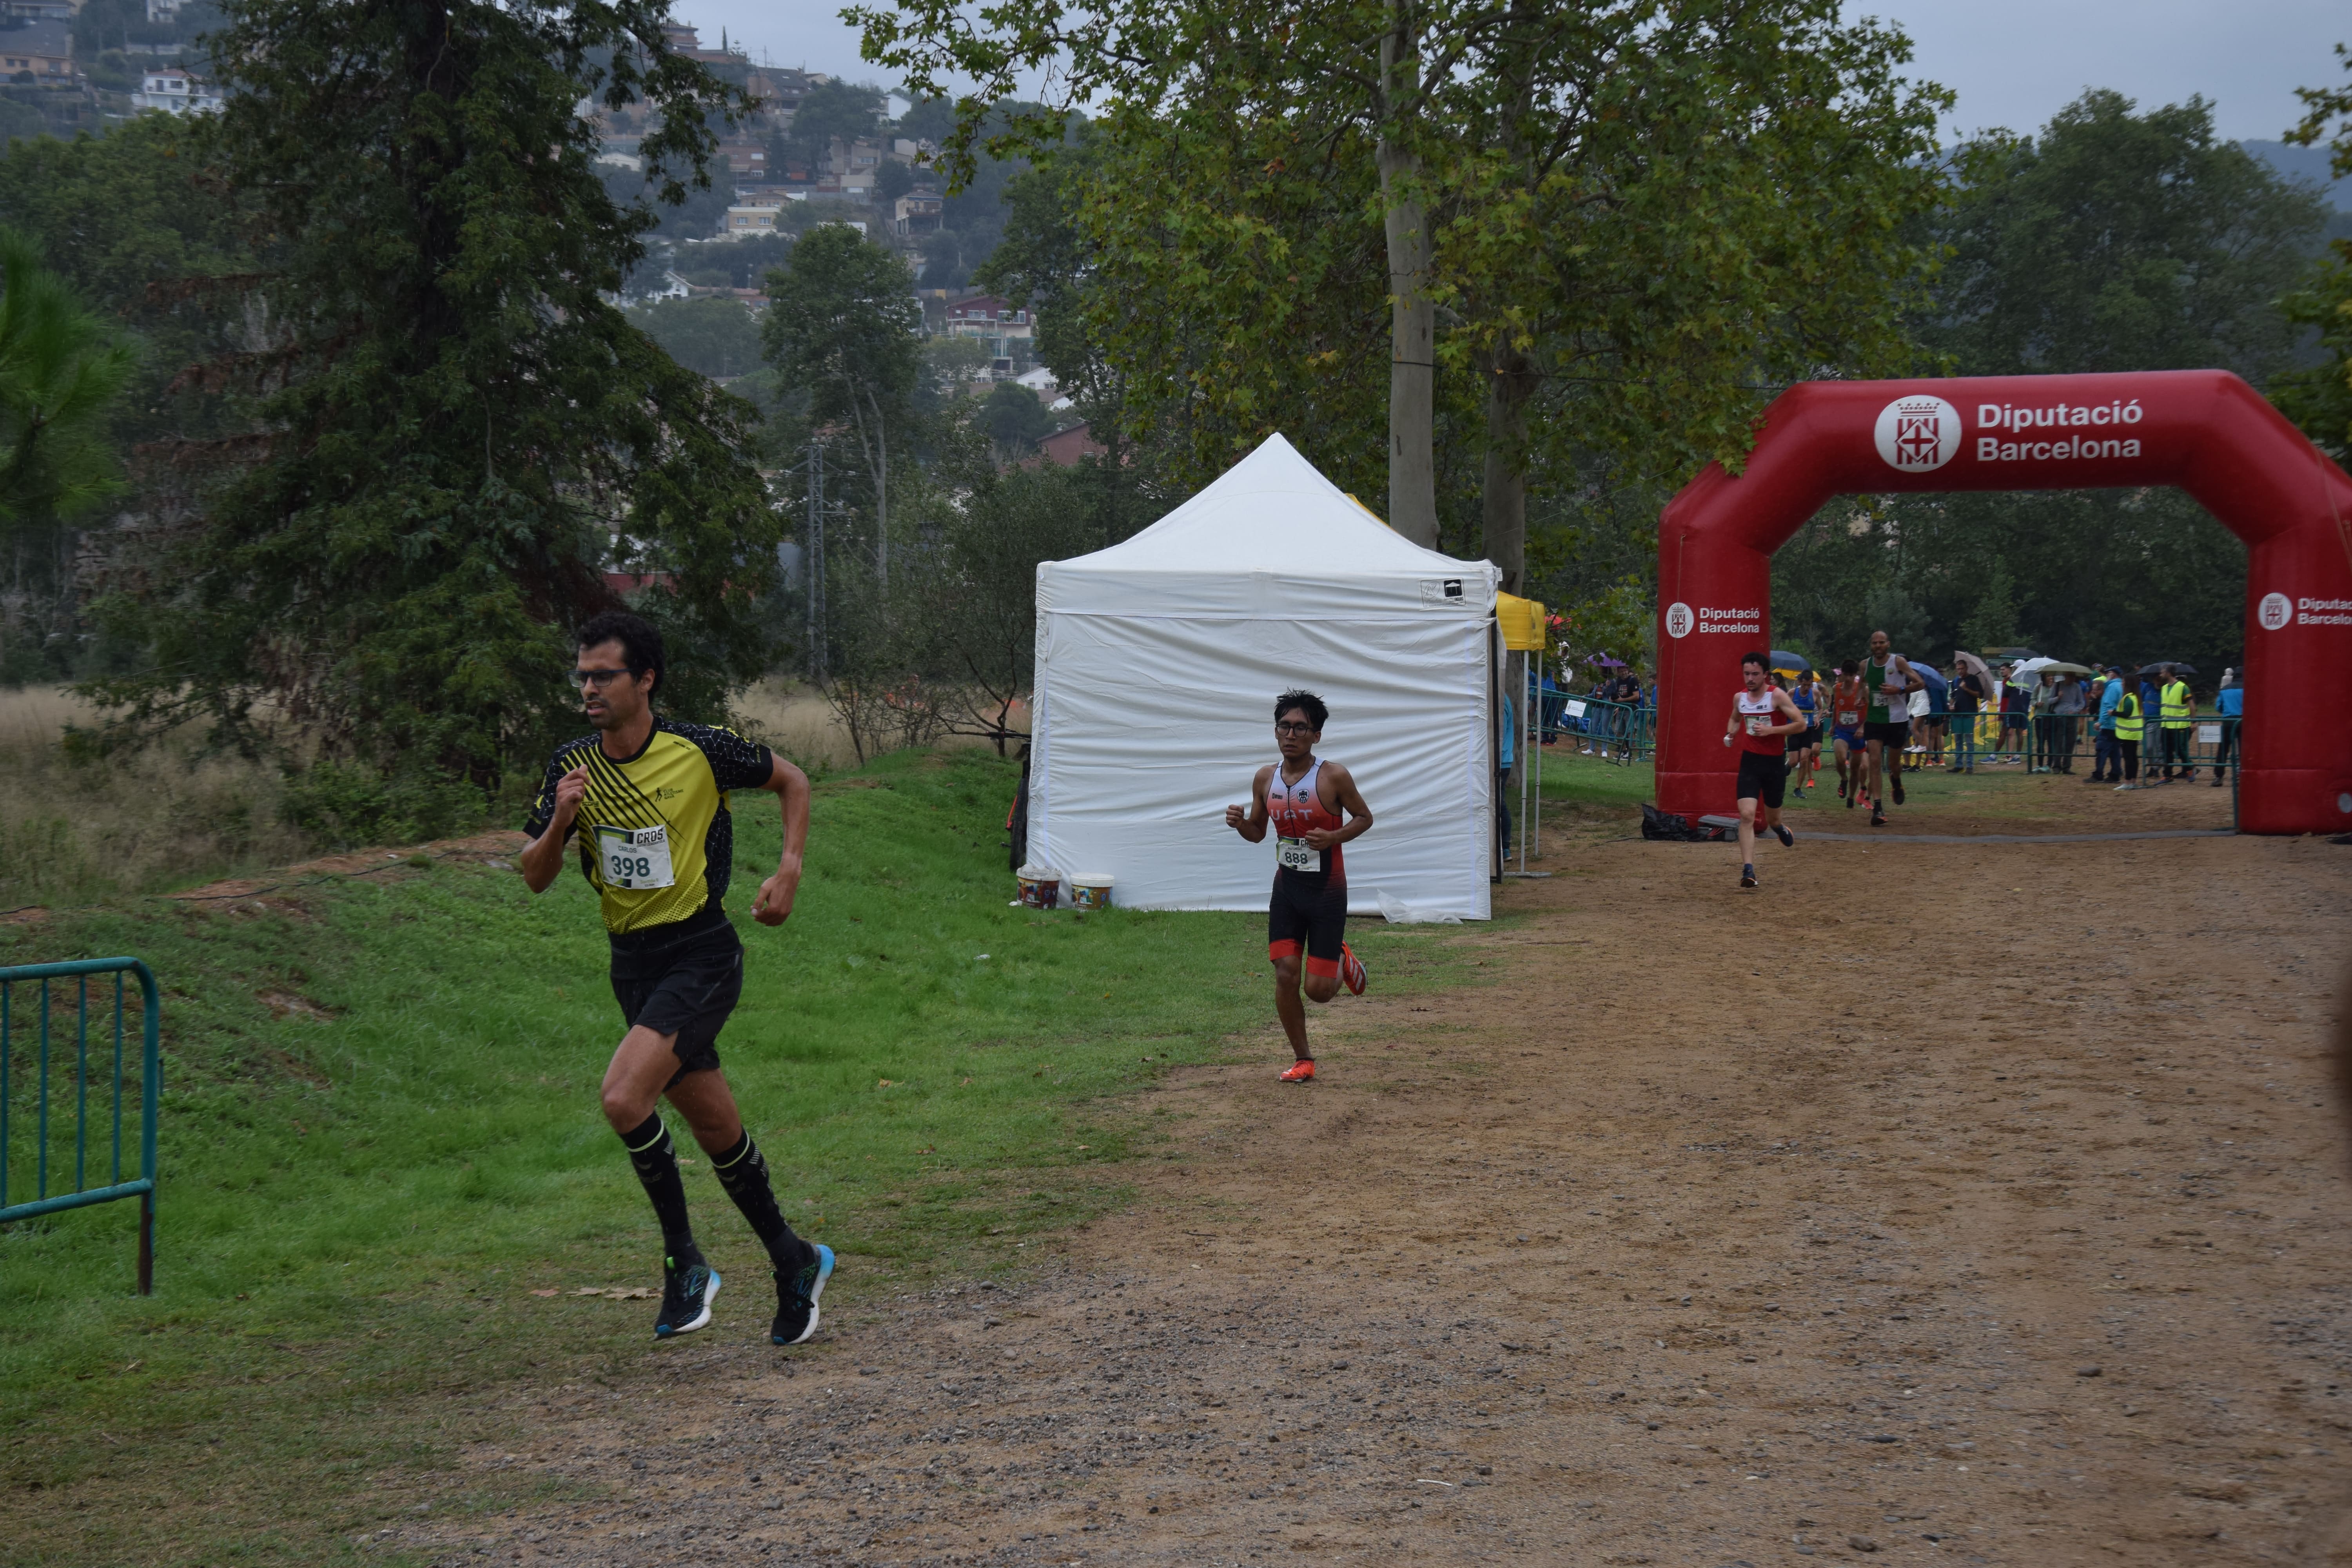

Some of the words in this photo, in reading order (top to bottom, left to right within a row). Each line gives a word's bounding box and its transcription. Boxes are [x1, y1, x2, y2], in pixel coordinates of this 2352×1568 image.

[1978, 399, 2143, 433] Diputació
[1977, 435, 2141, 461] Barcelona
[1699, 608, 1760, 621] Diputació
[2297, 613, 2352, 625] Barcelo
[1699, 622, 1760, 633] Barcelona
[1270, 809, 1313, 821] UAT
[637, 828, 664, 844] CROS
[1285, 852, 1308, 864] 888
[611, 855, 650, 877] 398
